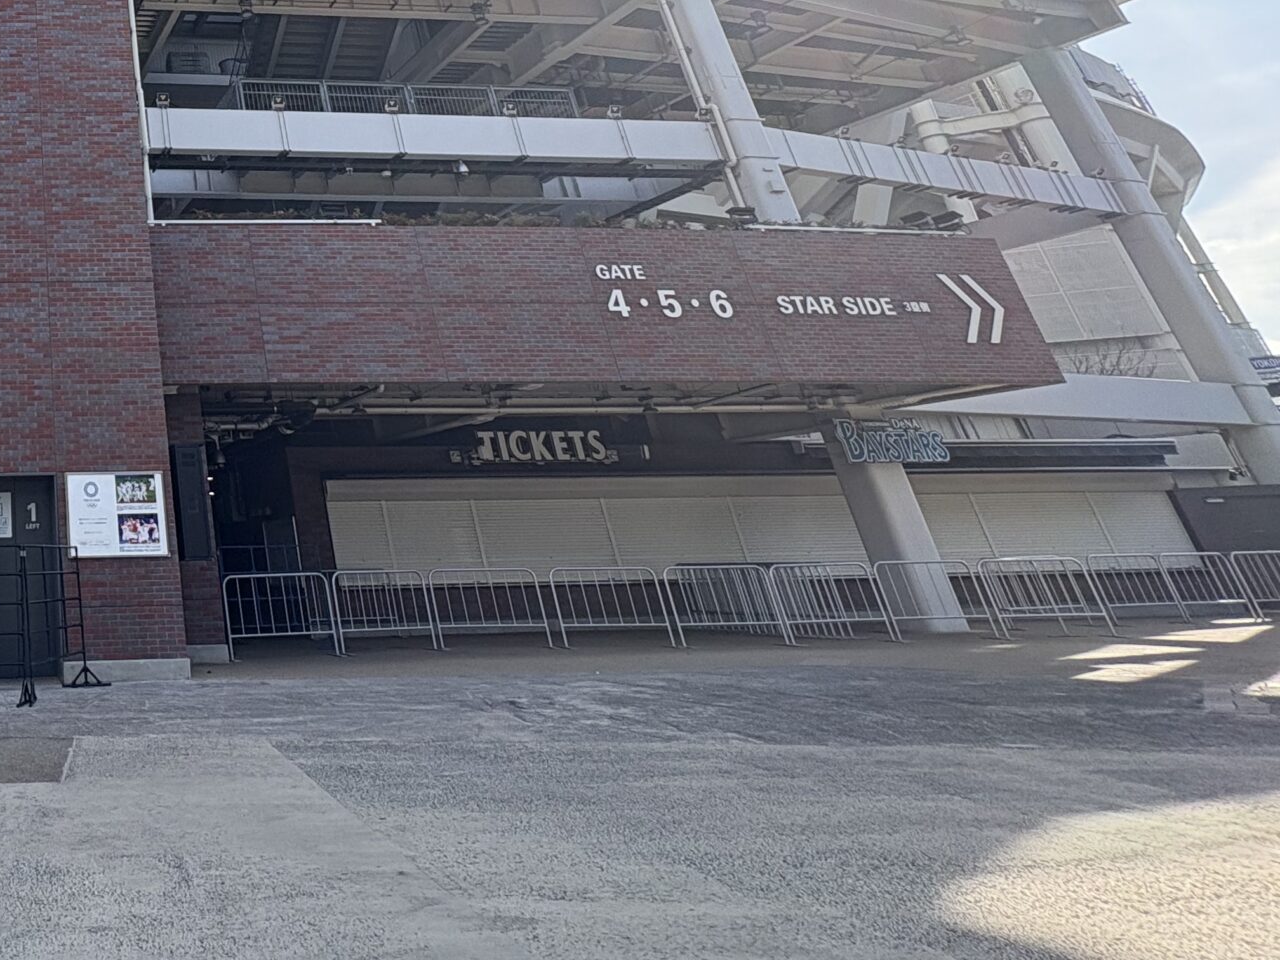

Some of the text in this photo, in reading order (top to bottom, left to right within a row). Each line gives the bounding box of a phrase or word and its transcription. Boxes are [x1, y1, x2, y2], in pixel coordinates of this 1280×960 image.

[595, 264, 646, 280] GATE
[776, 295, 838, 315] STAR
[841, 296, 897, 316] SIDE
[891, 418, 921, 430] DeNA
[476, 430, 607, 461] TICKETS
[833, 418, 950, 463] BAYSTARS
[26, 502, 36, 522] 1
